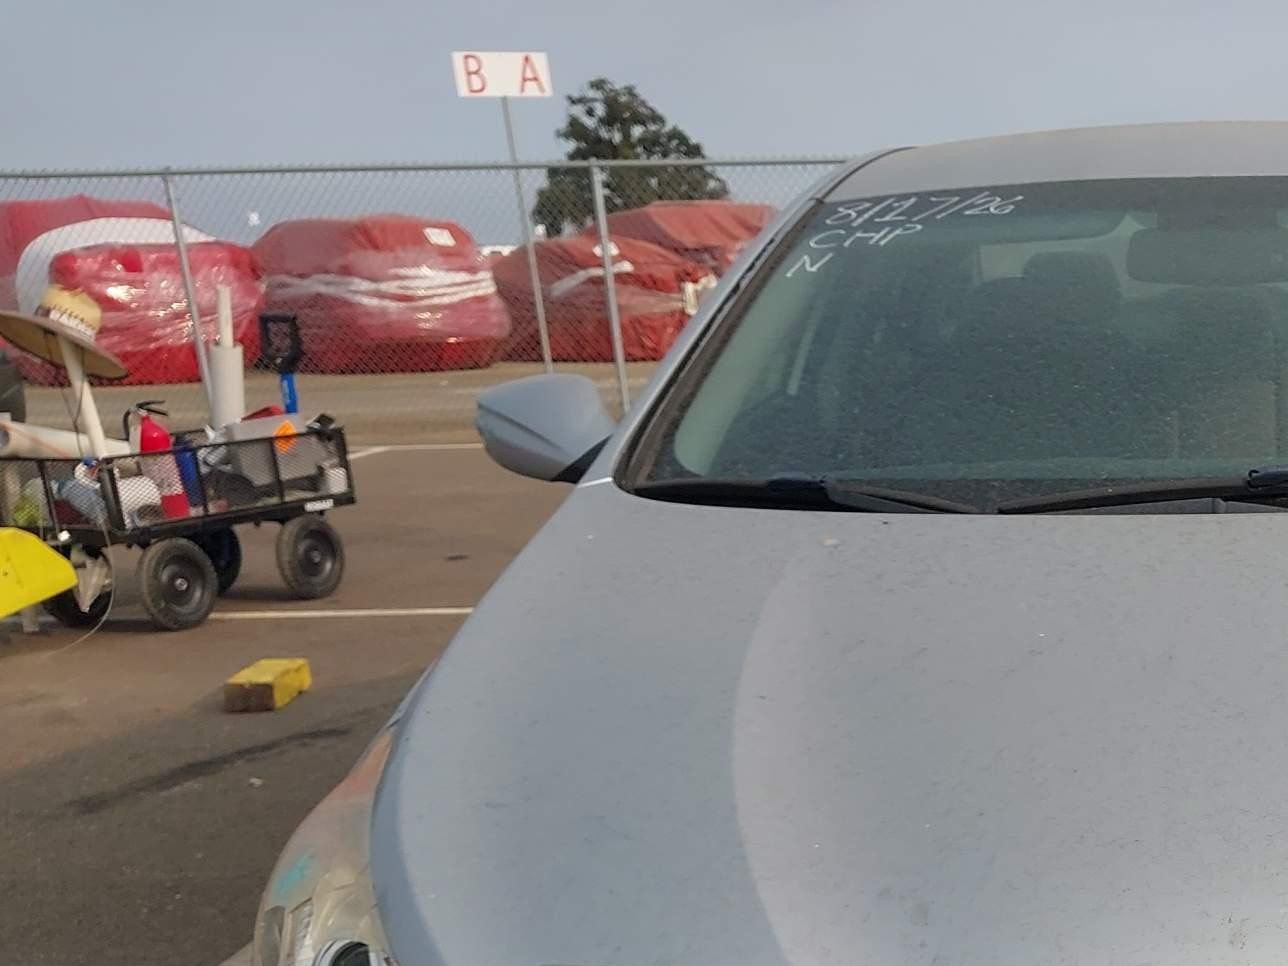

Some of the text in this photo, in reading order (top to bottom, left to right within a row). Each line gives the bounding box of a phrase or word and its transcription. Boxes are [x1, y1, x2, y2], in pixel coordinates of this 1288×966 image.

[463, 54, 546, 94] B A
[825, 191, 1024, 227] 8/17/26
[809, 223, 923, 249] CHP
[785, 252, 834, 278] N
